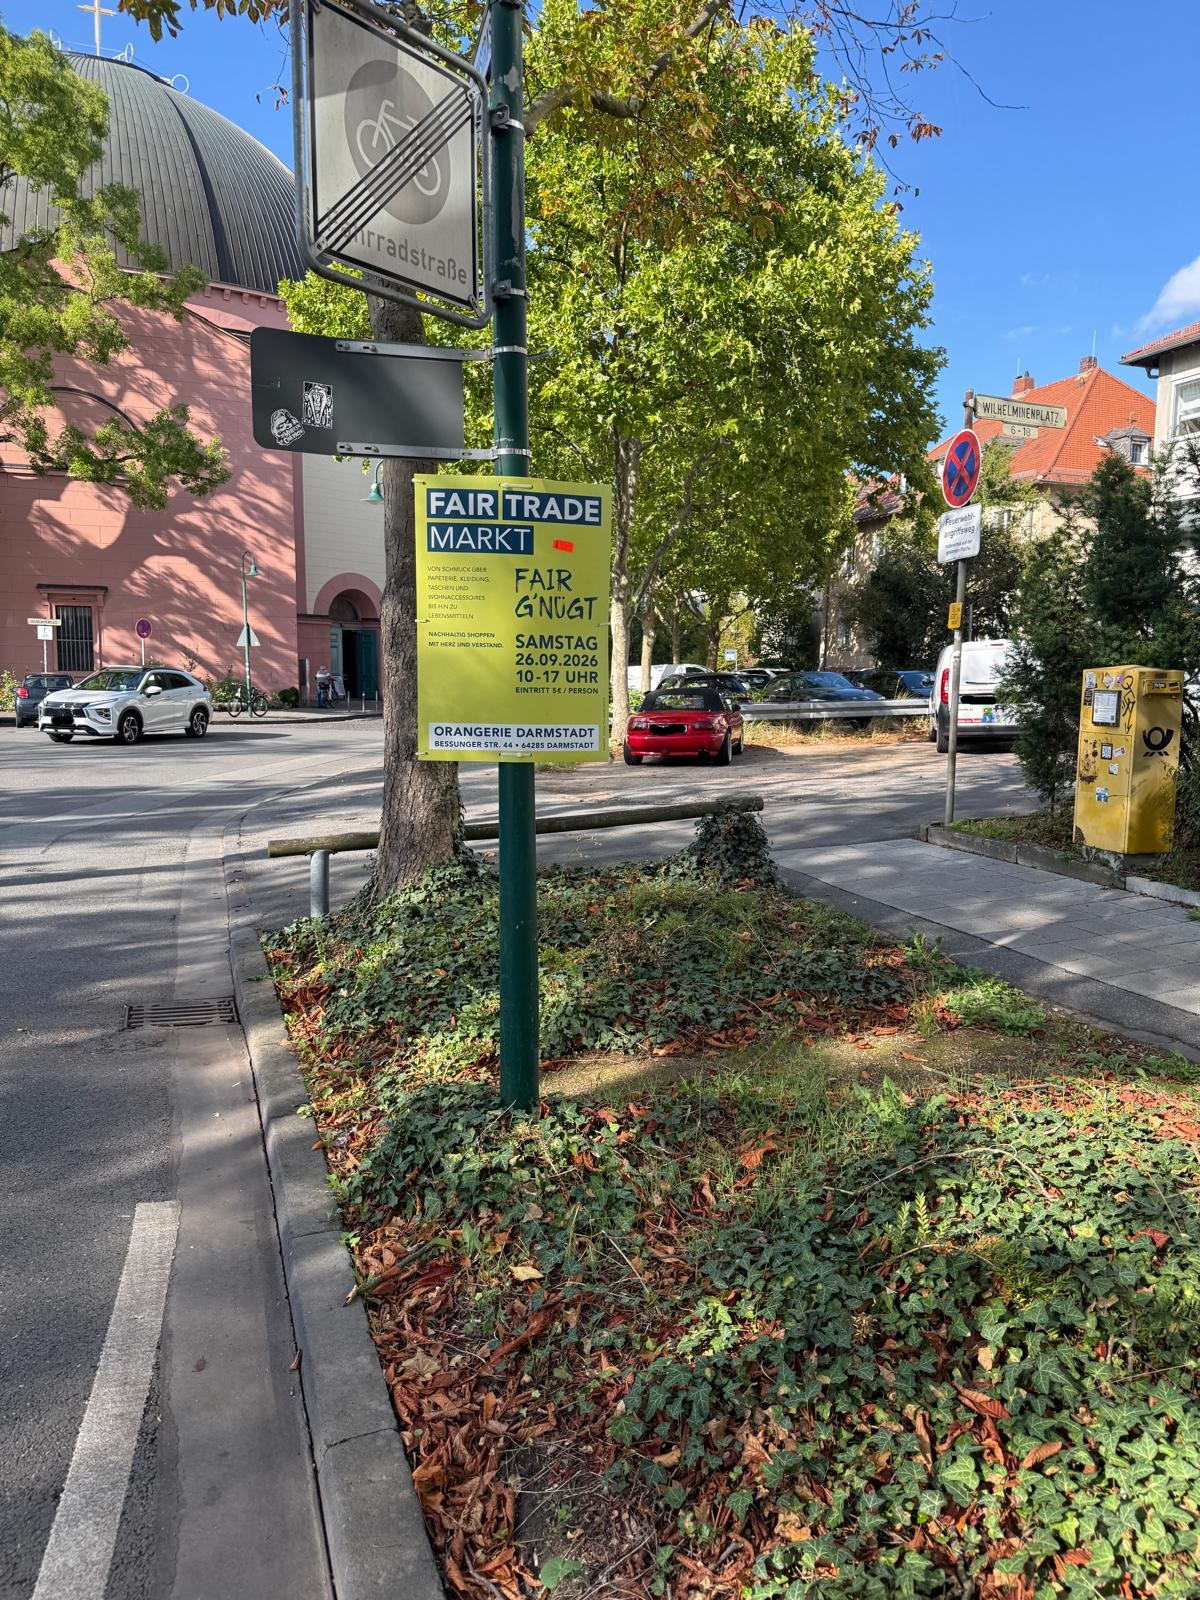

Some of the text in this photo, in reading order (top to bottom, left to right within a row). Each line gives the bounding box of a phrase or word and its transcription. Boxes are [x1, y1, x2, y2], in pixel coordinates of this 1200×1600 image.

[982, 402, 1059, 423] WILHELMINENPLATZ
[430, 492, 600, 522] FAIR TRADE
[430, 526, 531, 551] MARKT
[515, 568, 572, 592] FAIR
[516, 634, 598, 650] SAMSTAG
[516, 653, 598, 667] 26.09.2026
[566, 671, 598, 683] UHR
[434, 726, 594, 737] ORANGERIE DARMSTADT
